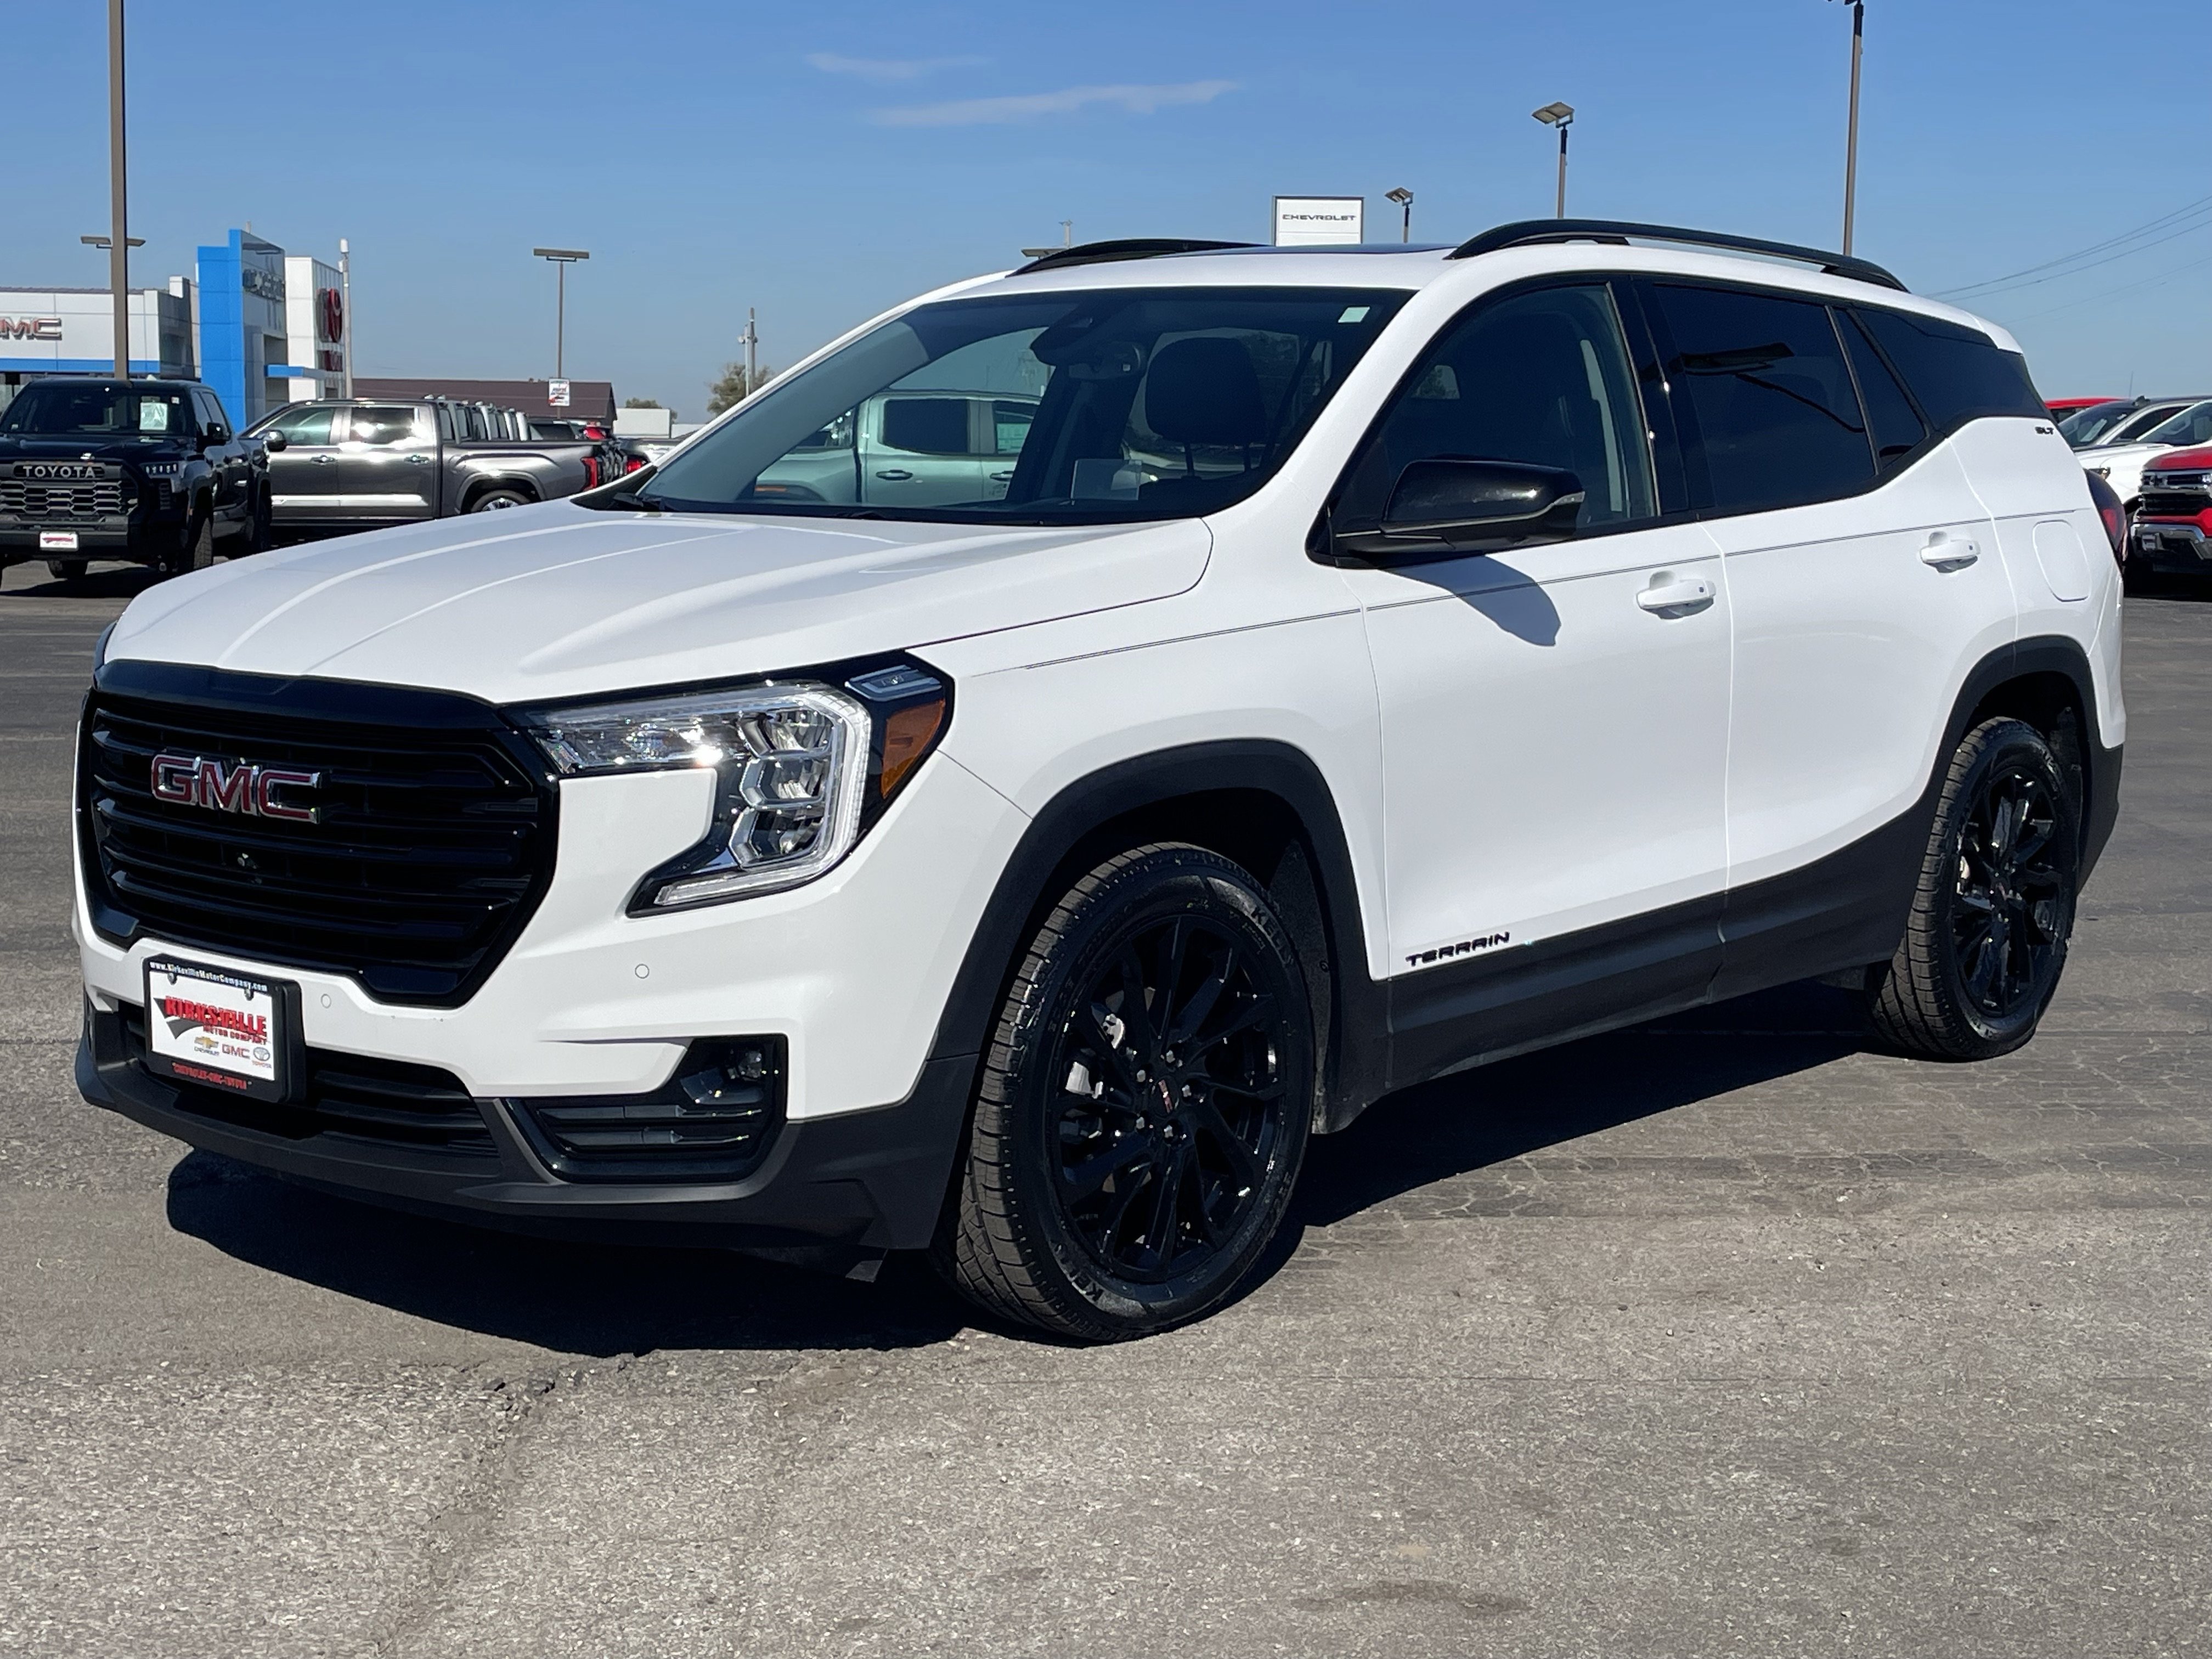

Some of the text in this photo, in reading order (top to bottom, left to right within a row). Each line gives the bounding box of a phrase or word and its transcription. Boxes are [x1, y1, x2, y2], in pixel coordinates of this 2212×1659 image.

[0, 317, 62, 340] MC
[23, 465, 95, 478] TOYOTA
[151, 754, 320, 824] GMC
[1405, 932, 1510, 967] TERRAIN
[165, 995, 267, 1037] KIRKSVILLE
[222, 1043, 250, 1059] GMC
